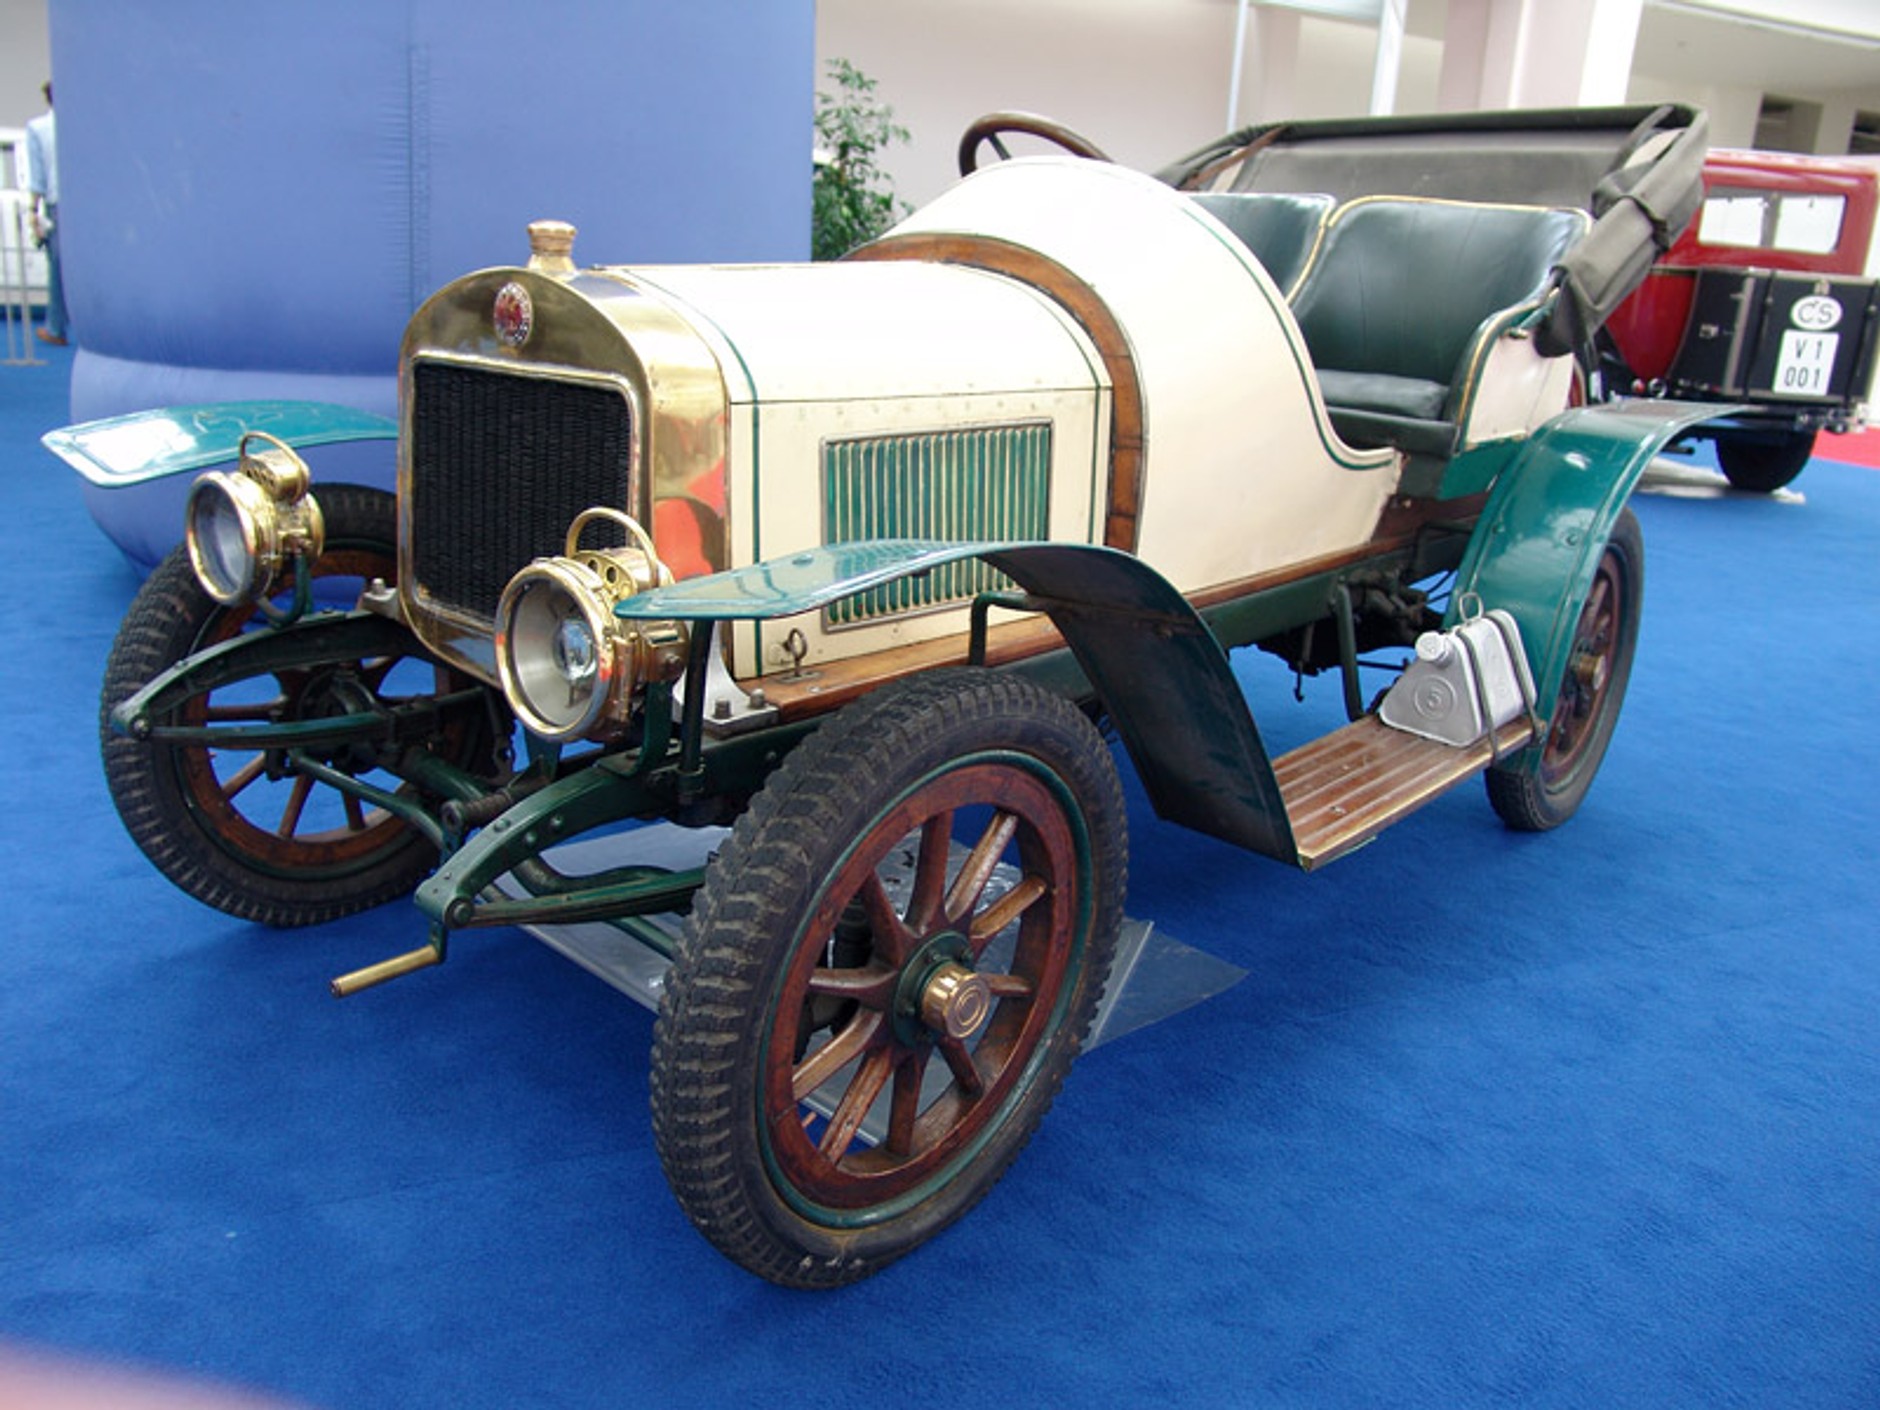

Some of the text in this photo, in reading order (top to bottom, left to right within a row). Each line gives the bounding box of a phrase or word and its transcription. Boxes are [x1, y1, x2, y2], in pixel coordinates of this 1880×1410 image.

[1795, 339, 1823, 360] V 1
[1784, 366, 1821, 388] 001
